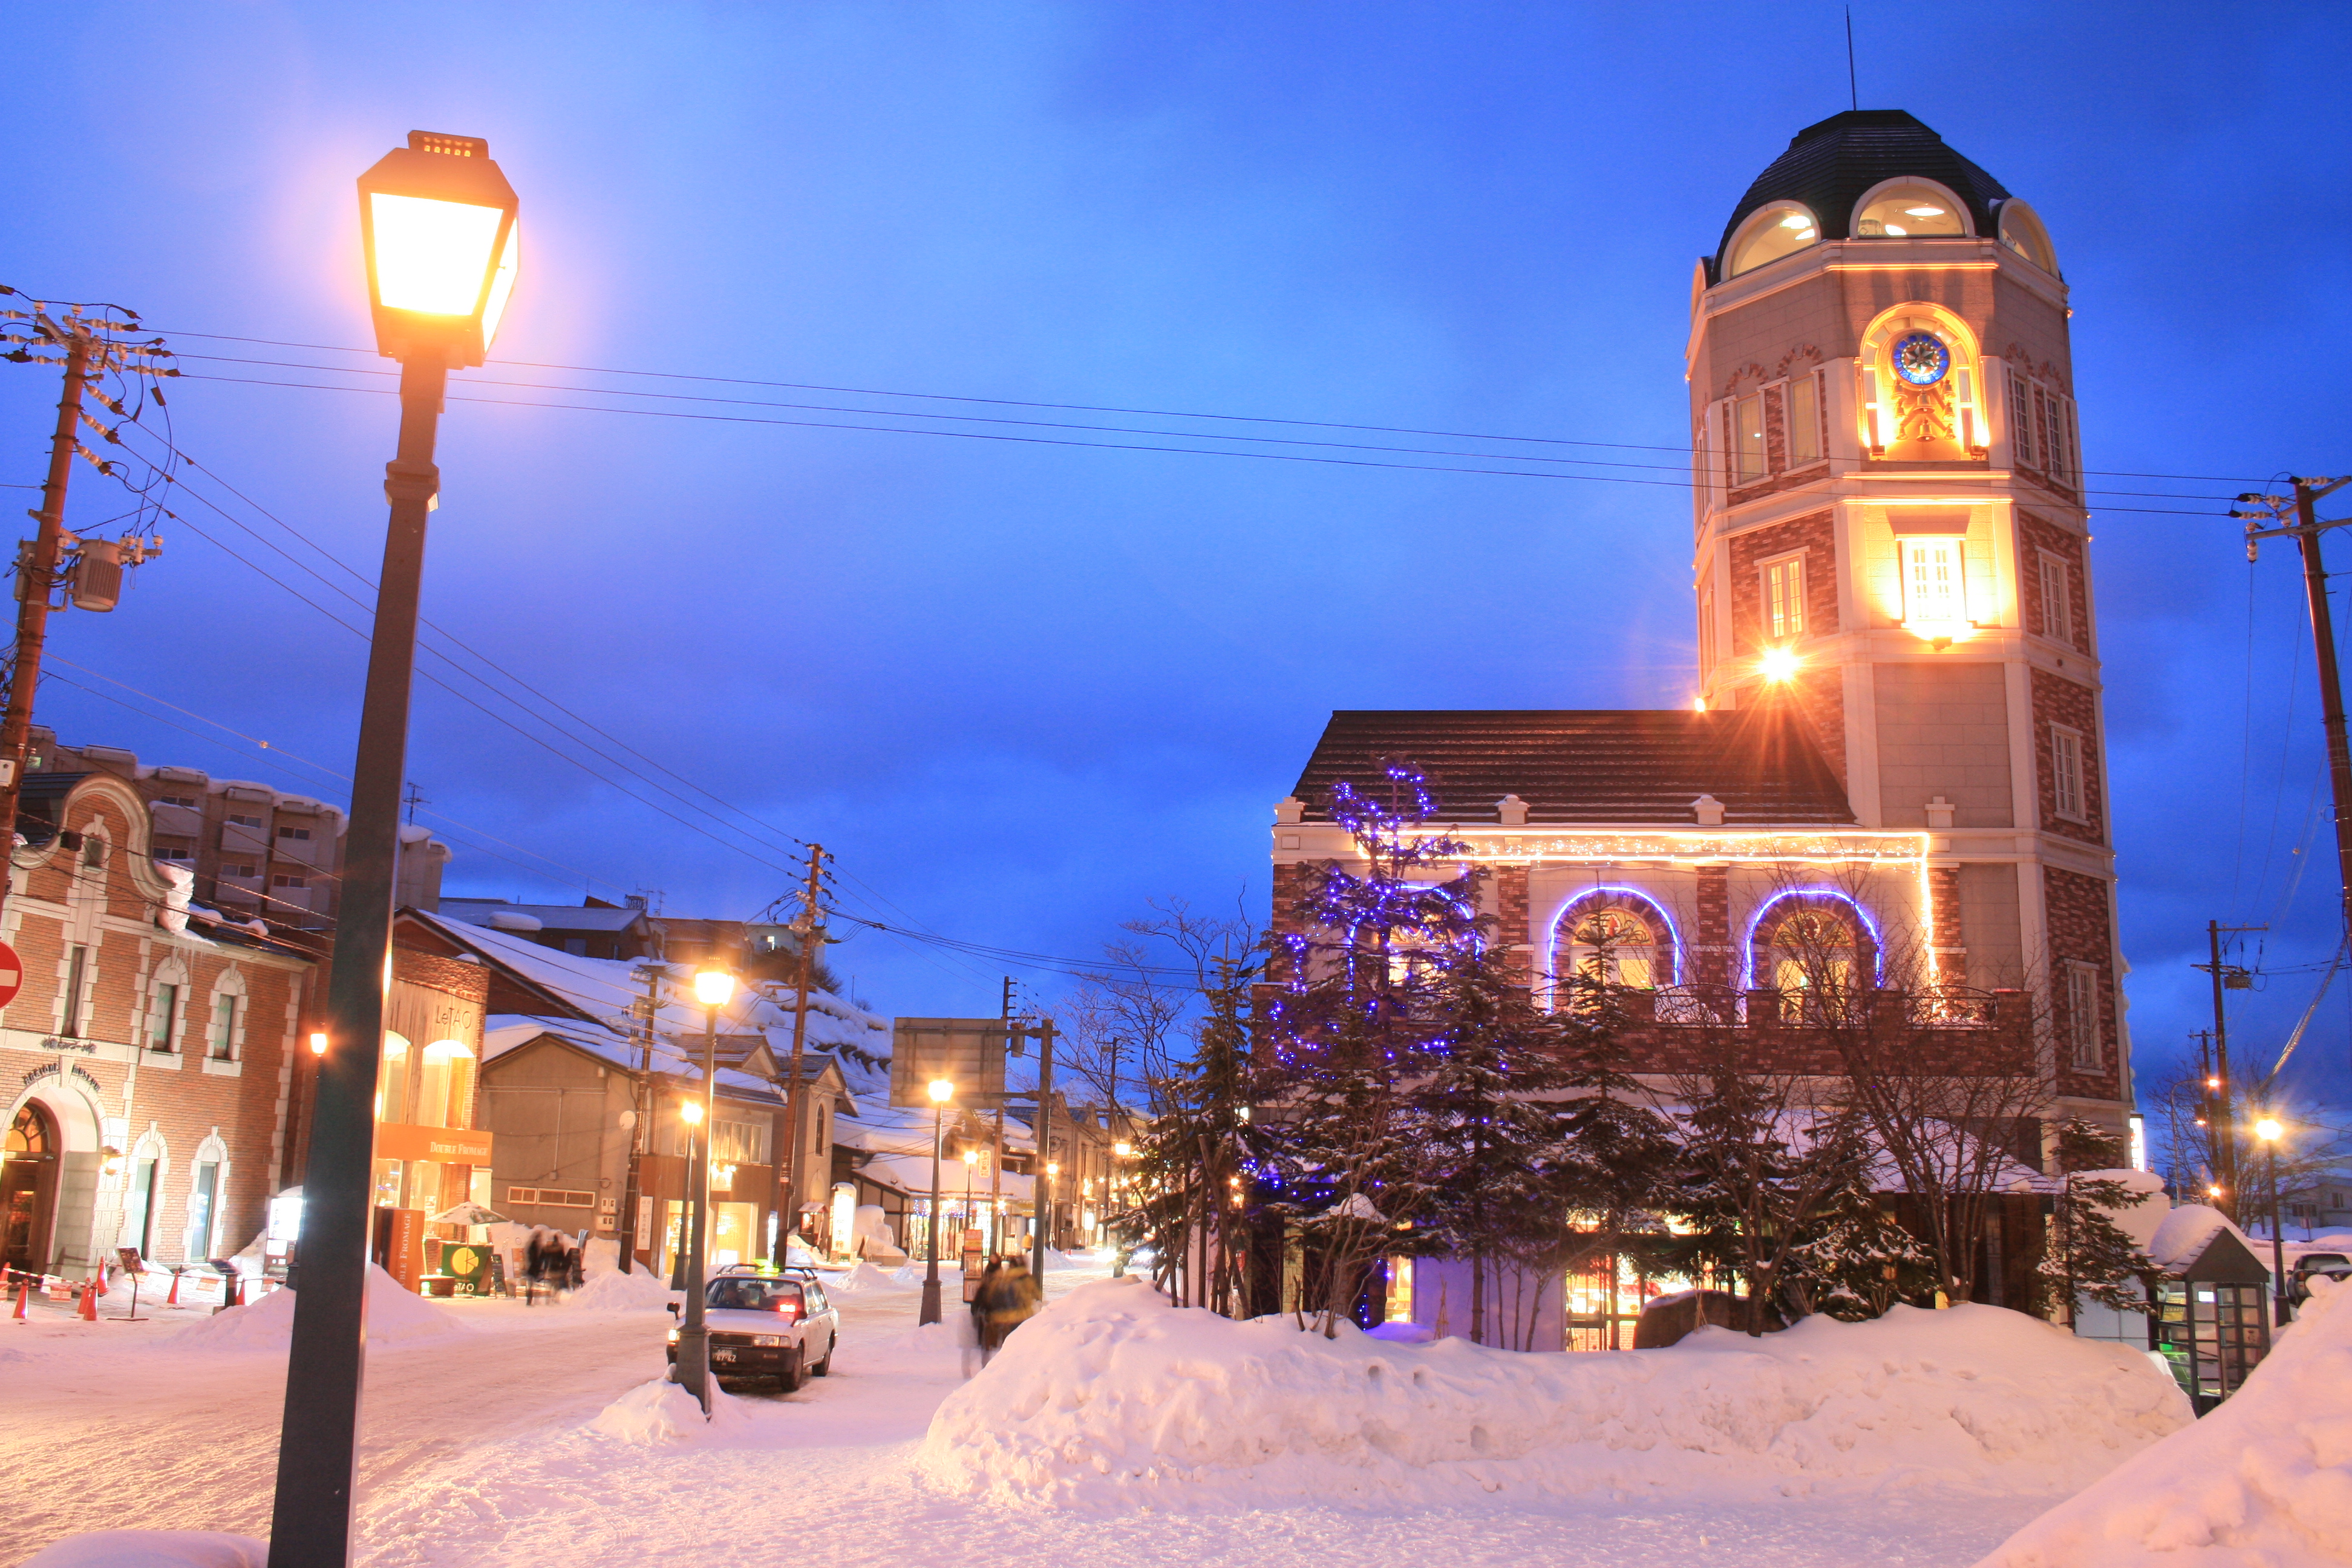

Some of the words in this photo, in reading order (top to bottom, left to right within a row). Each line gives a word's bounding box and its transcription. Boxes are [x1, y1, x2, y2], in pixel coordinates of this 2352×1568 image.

[436, 1005, 472, 1029] LeTAO
[430, 1142, 457, 1154] DOUBLE
[457, 1144, 488, 1155] FROMAGE
[399, 1213, 411, 1259] FROMAGE
[454, 1282, 475, 1292] eTAO
